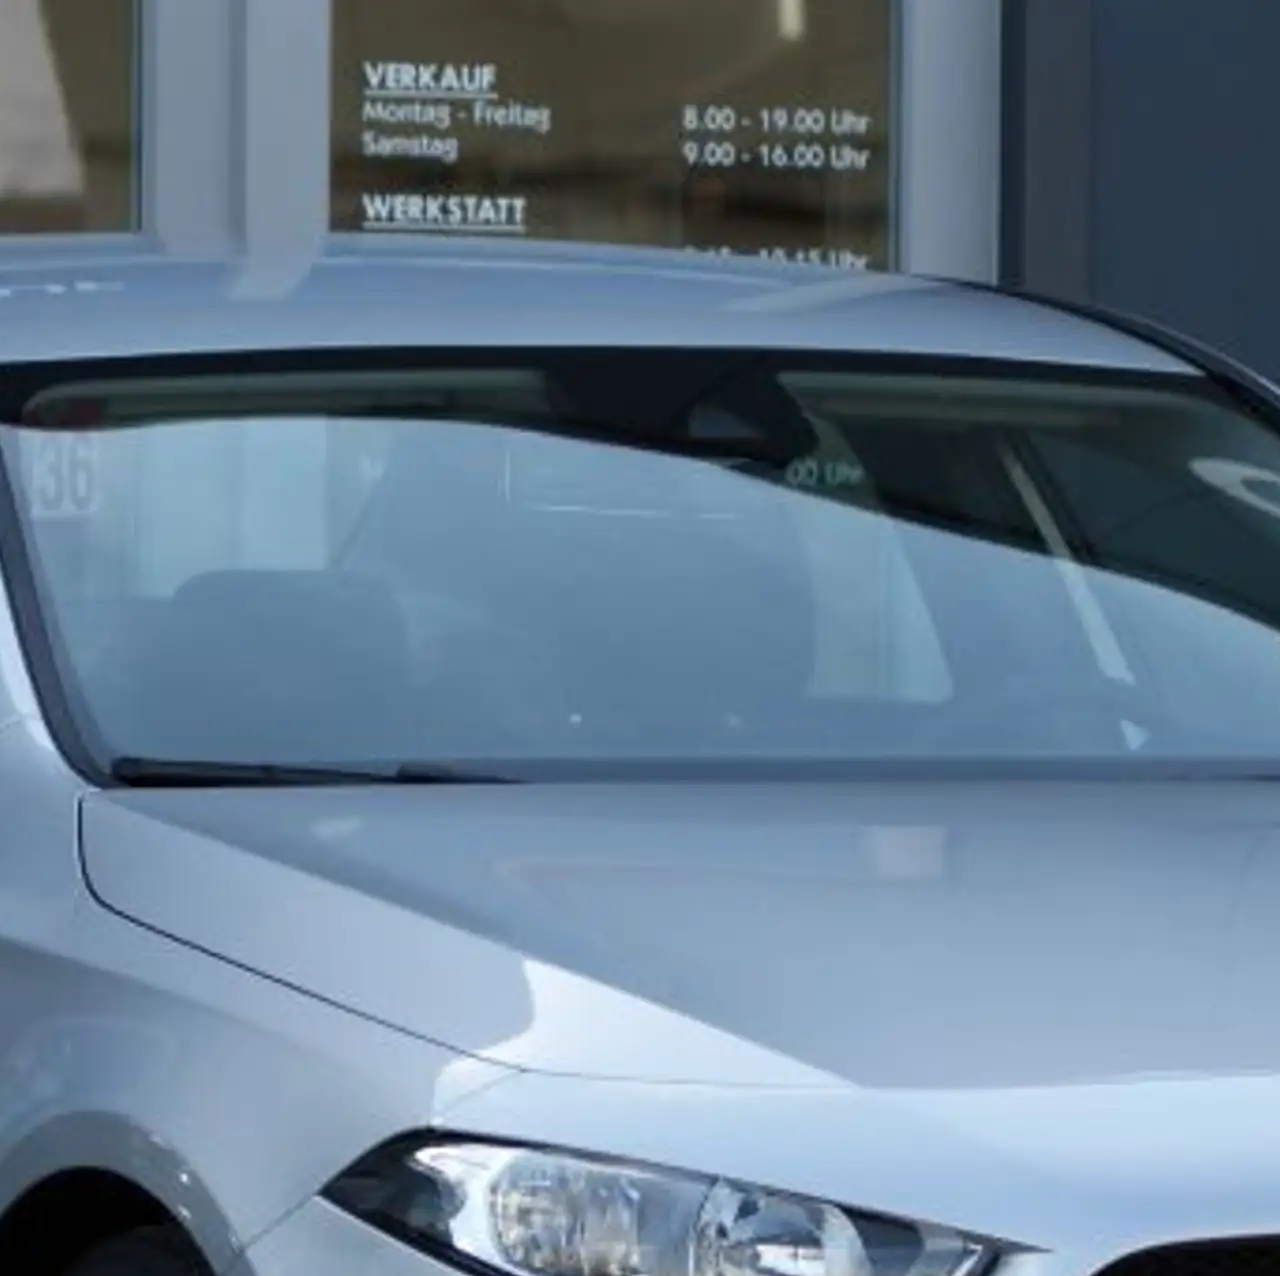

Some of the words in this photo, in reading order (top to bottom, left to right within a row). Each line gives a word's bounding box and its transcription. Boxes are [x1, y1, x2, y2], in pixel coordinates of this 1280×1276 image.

[363, 62, 497, 91] VERKAUF
[363, 101, 451, 129] Montag
[473, 99, 551, 134] Freitag
[683, 105, 736, 131] 8.00
[760, 108, 825, 133] 19.00
[830, 107, 870, 136] Uhr
[363, 130, 458, 164] Samstag
[683, 141, 735, 166] 9.00
[759, 143, 824, 167] 16.00
[830, 144, 869, 170] Uhr
[362, 194, 526, 225] WERKSTATT
